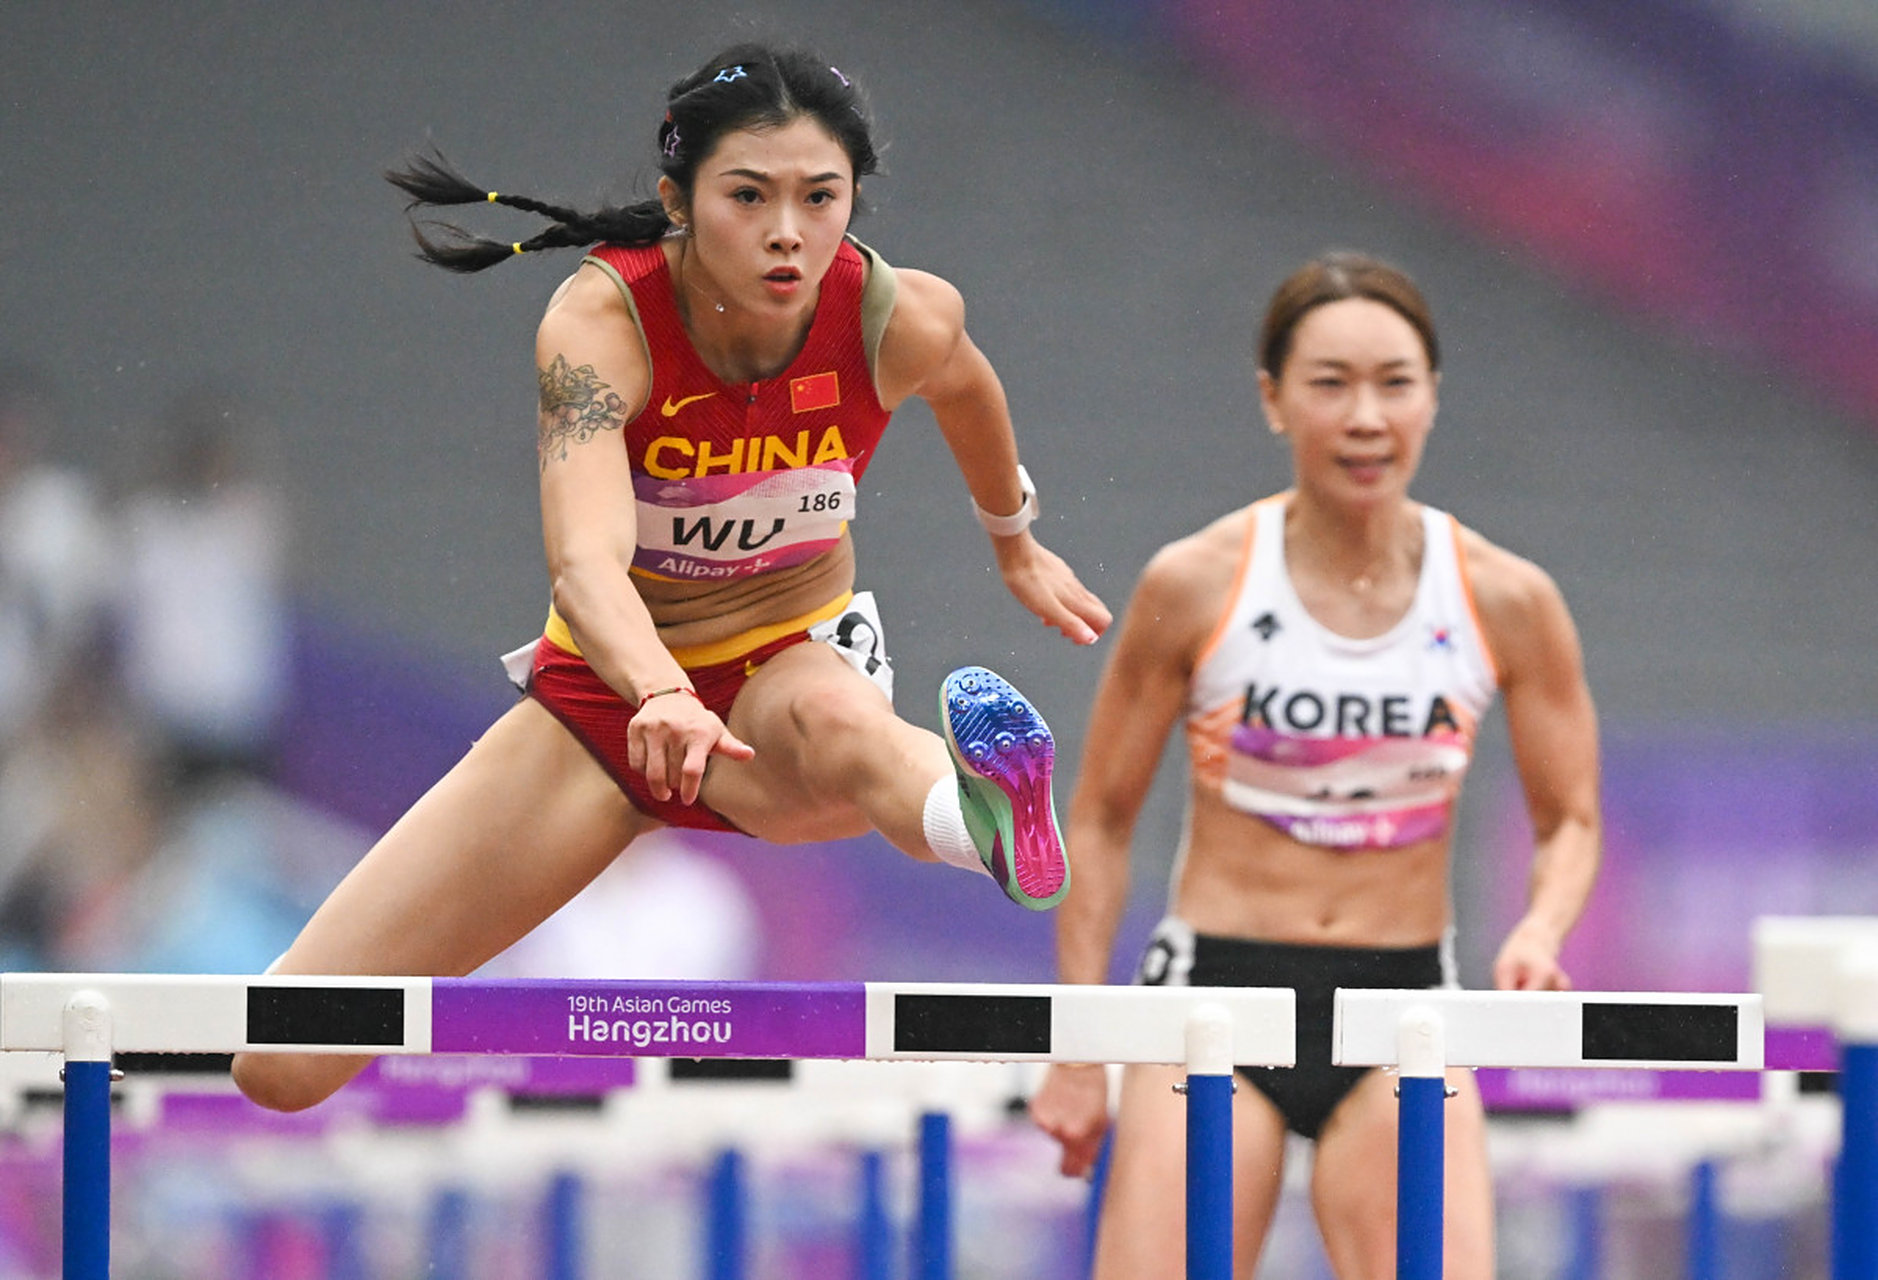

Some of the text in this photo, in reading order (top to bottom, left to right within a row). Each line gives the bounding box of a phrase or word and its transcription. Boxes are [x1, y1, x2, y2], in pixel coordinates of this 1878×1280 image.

[643, 425, 848, 480] CHINA
[798, 491, 841, 513] 186
[672, 516, 785, 551] WU
[657, 557, 739, 577] Alipay
[1240, 681, 1461, 737] KOREA
[567, 996, 732, 1013] 19th Asian Games
[568, 1014, 732, 1048] Hangzhou
